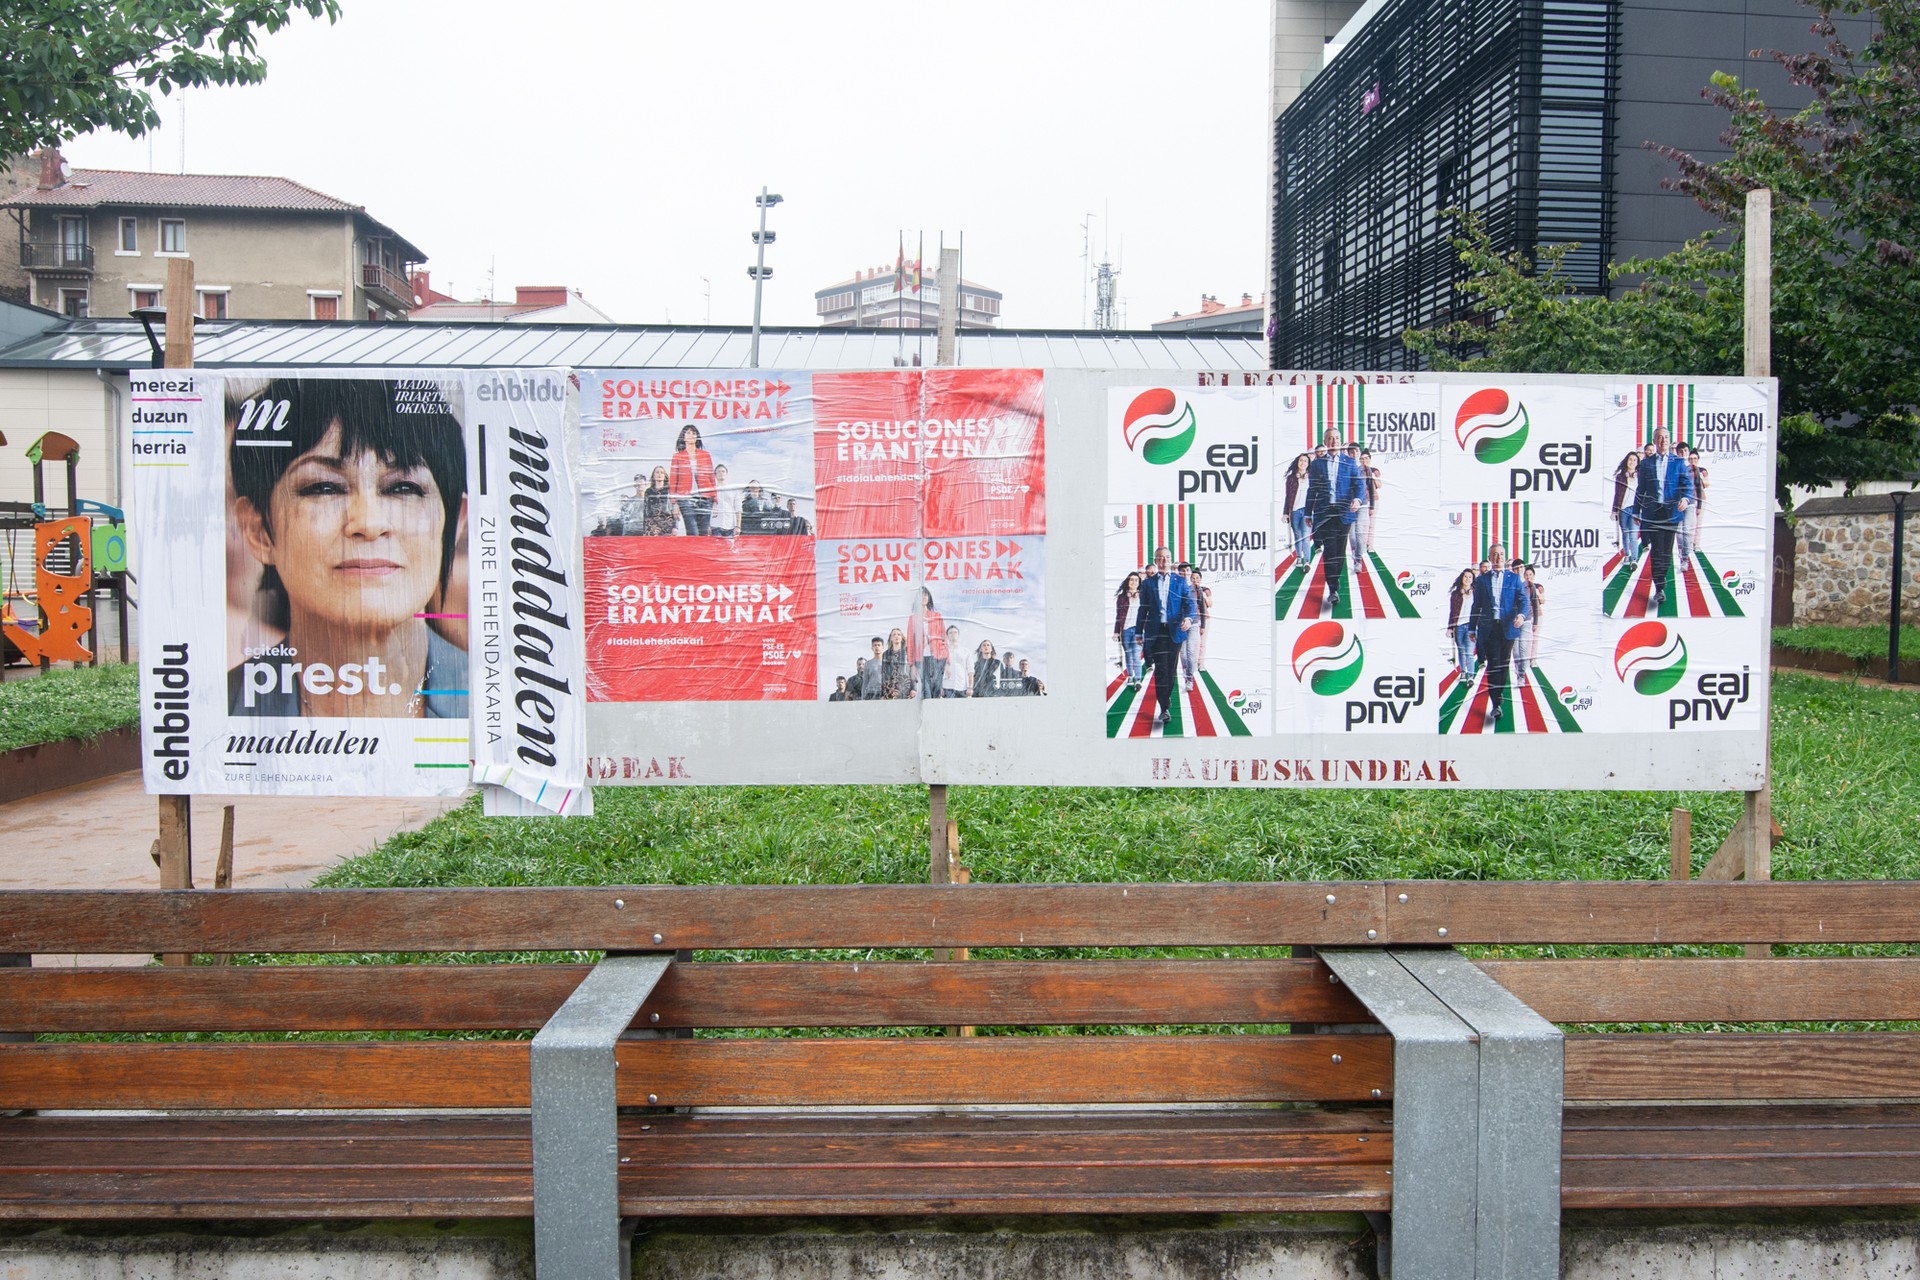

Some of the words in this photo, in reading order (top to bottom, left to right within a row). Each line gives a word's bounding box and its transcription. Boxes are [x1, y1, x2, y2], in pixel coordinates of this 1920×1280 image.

[130, 376, 194, 392] merezi
[477, 378, 564, 401] ehbildu
[602, 379, 760, 399] SOLUCIONES
[395, 391, 448, 402] IRIARTE
[131, 407, 188, 423] duzun
[395, 401, 453, 414] OKIÑENA
[602, 401, 792, 420] ERANTZUNAK
[836, 418, 991, 441] SOLUCIONES
[1367, 412, 1436, 432] EUSKADI
[1696, 412, 1763, 432] EUSKADI
[132, 438, 187, 454] herria
[1367, 432, 1414, 453] ZUTIK
[1695, 433, 1742, 452] ZUTIK
[1206, 435, 1259, 475] eaj
[1538, 435, 1593, 474] eaj
[1178, 468, 1245, 501] pnv
[1510, 467, 1578, 499] pnv
[480, 516, 497, 570] ZURE
[1198, 531, 1266, 551] EUSKADI
[1532, 529, 1599, 548] EUSKADI
[837, 540, 990, 563] SOLUCONES
[1198, 552, 1245, 572] ZUTIK
[1532, 550, 1577, 568] ZUTIK
[838, 561, 1024, 584] ERANZUNAK
[508, 426, 574, 769] maddalen
[606, 584, 763, 604] SOLUCIONES
[607, 604, 794, 625] ERANTZUNAK
[244, 643, 298, 660] egiteko
[606, 636, 704, 647] #IdoiaLehendakari
[481, 580, 501, 745] LEHENDAKARIA
[762, 650, 785, 660] PSOE
[244, 656, 402, 708] prest.
[1373, 667, 1425, 706] eaj
[1697, 665, 1750, 703] eaj
[152, 642, 190, 781] ehbildu
[1346, 700, 1411, 731] pnv
[1669, 698, 1735, 730] pnv
[225, 729, 380, 756] maddalen
[224, 772, 251, 782] ZURE
[255, 772, 334, 783] LEHENDAKARIA
[1151, 758, 1461, 782] HAUTESKUNDEAK
